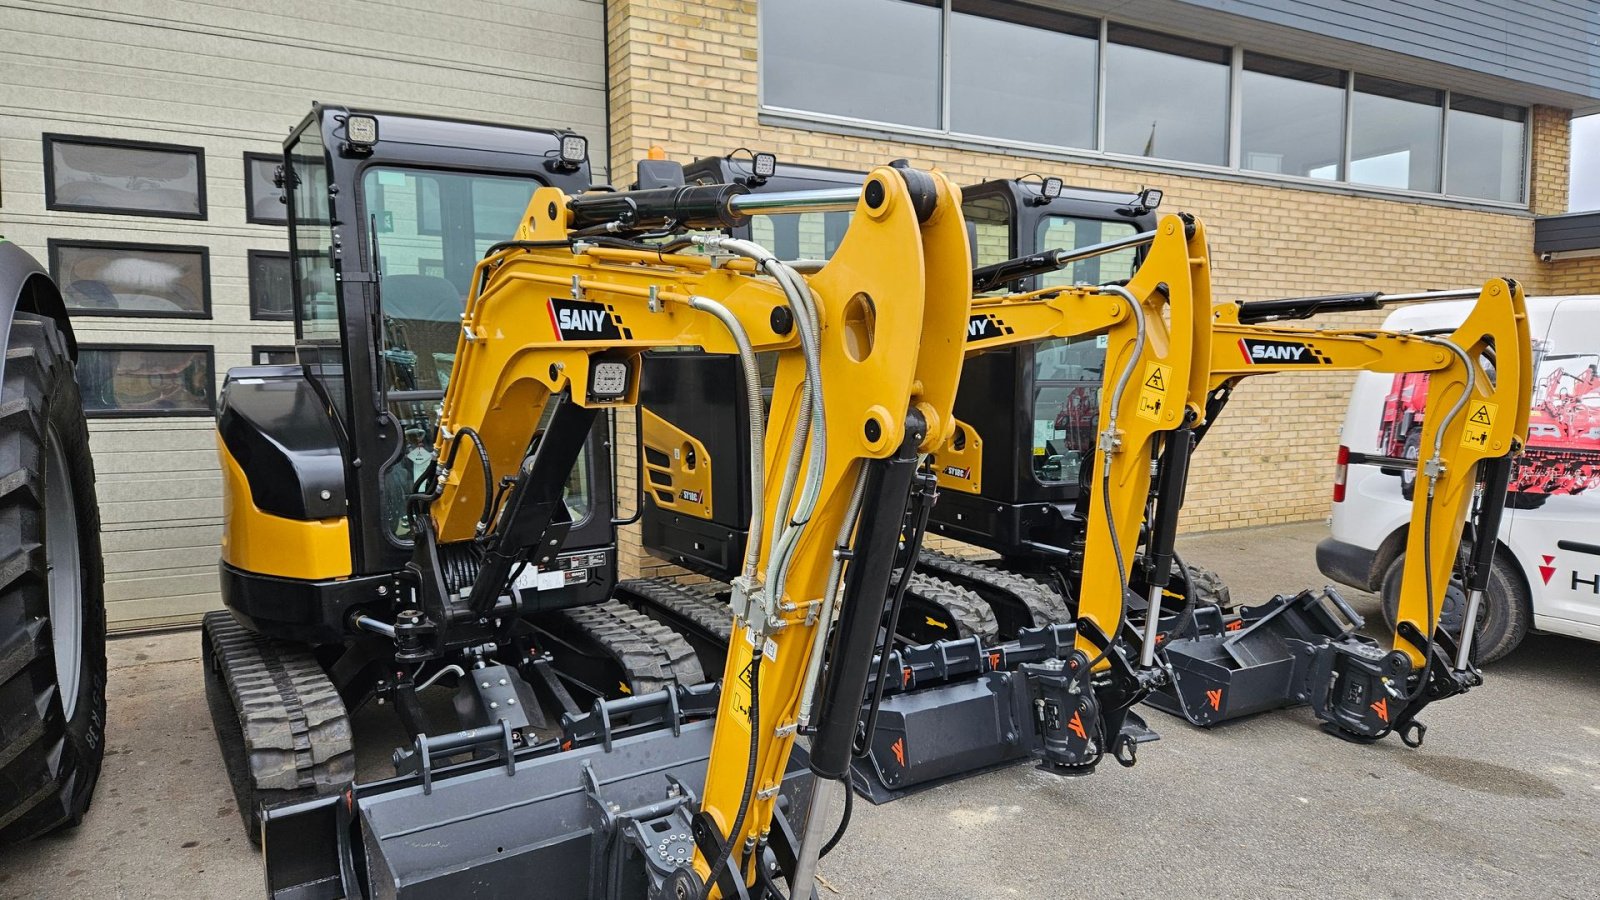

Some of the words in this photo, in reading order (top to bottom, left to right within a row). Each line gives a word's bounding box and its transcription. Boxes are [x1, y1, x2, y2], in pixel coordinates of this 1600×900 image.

[560, 308, 606, 332] SANY
[1252, 344, 1305, 360] SANY
[1571, 570, 1600, 594] H
